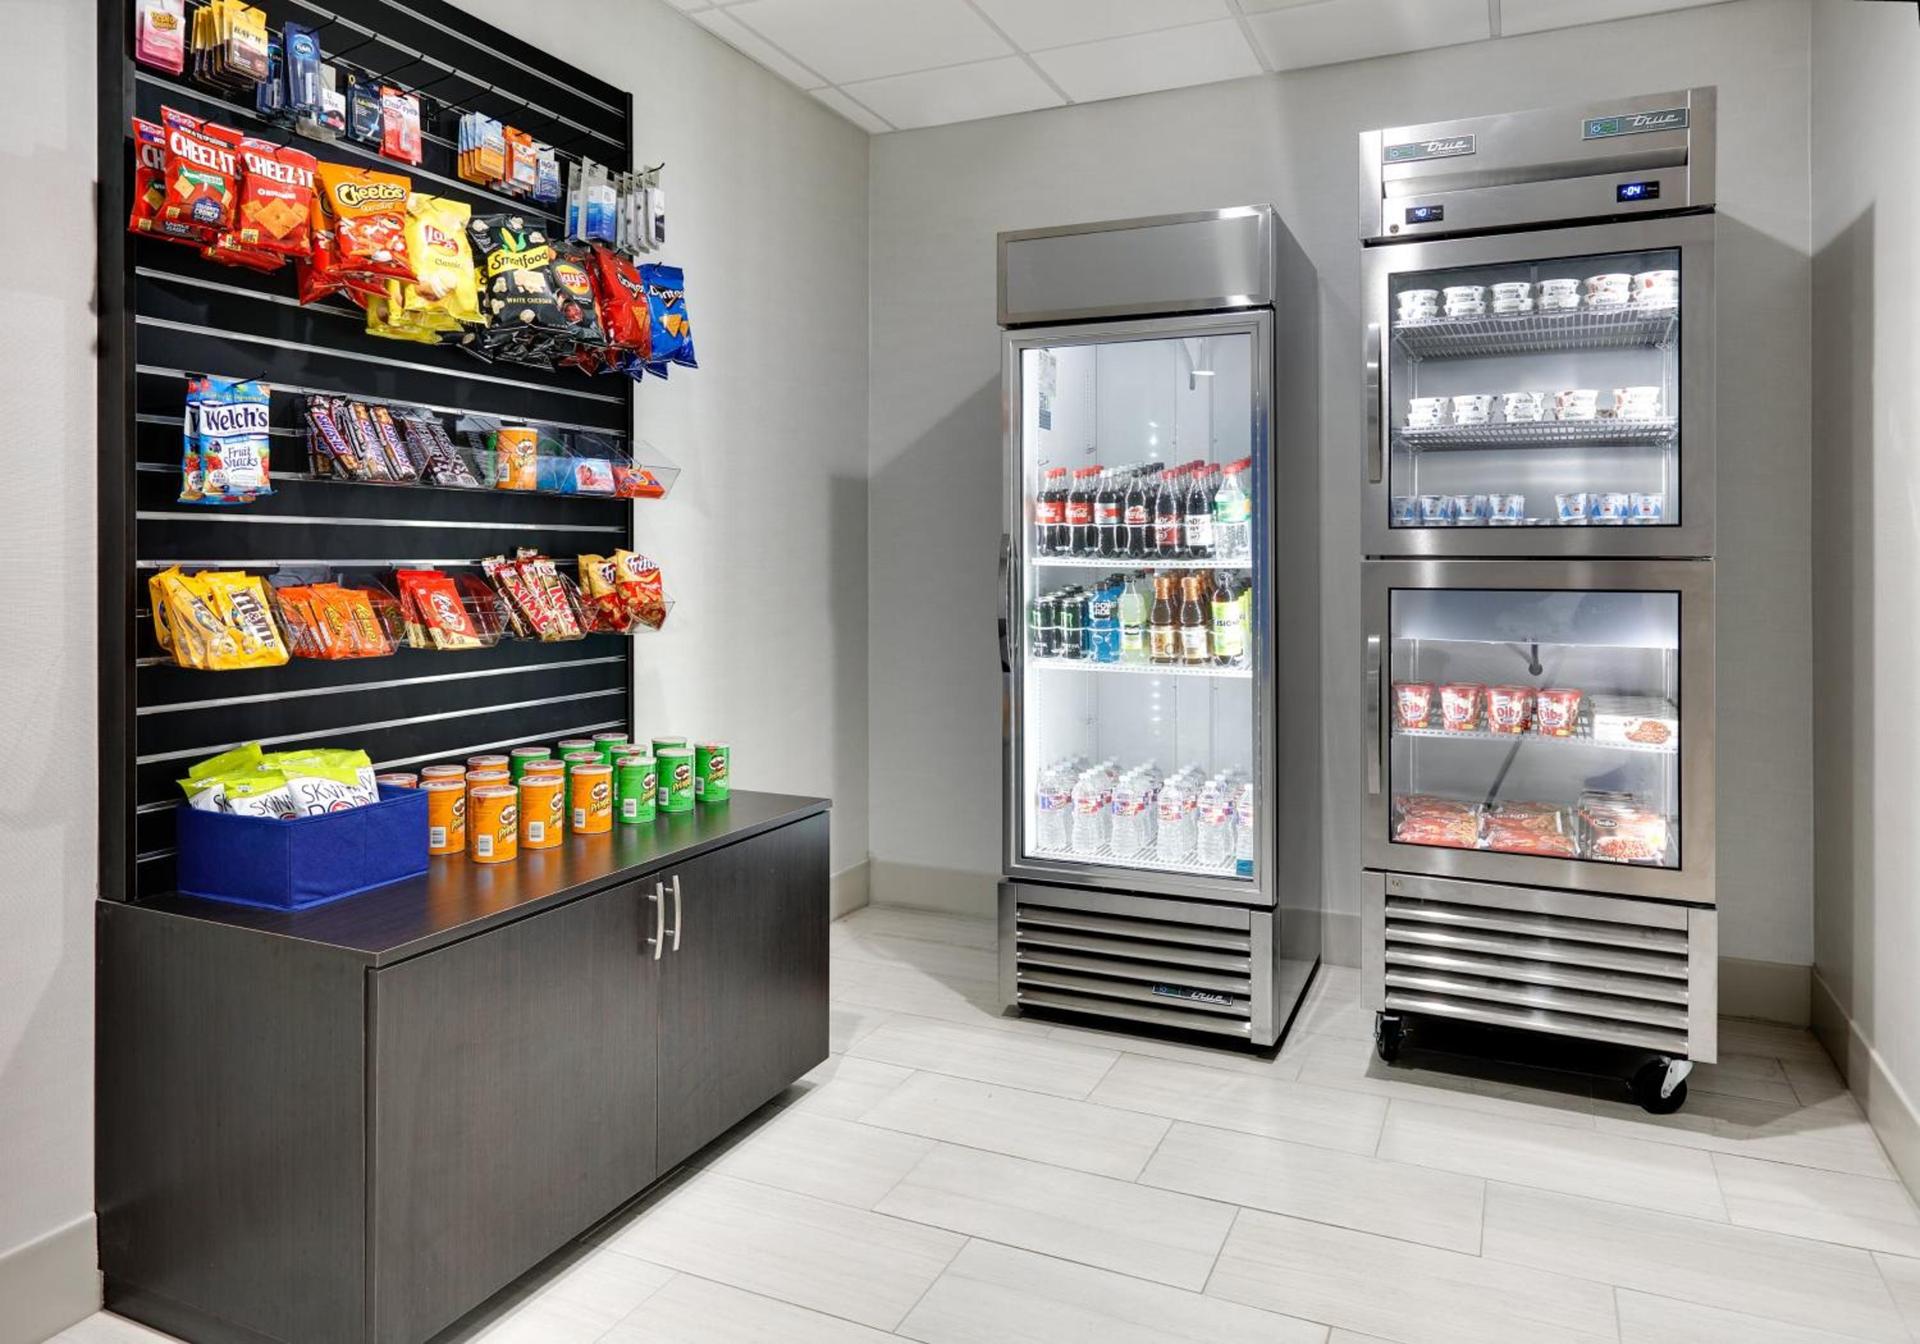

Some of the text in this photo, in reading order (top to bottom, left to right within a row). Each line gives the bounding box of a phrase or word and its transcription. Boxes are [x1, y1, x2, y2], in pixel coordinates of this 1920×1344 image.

[337, 183, 405, 208] Cheetos
[204, 407, 268, 431] Welch's
[228, 446, 252, 458] Fruit
[223, 457, 258, 471] Snacks
